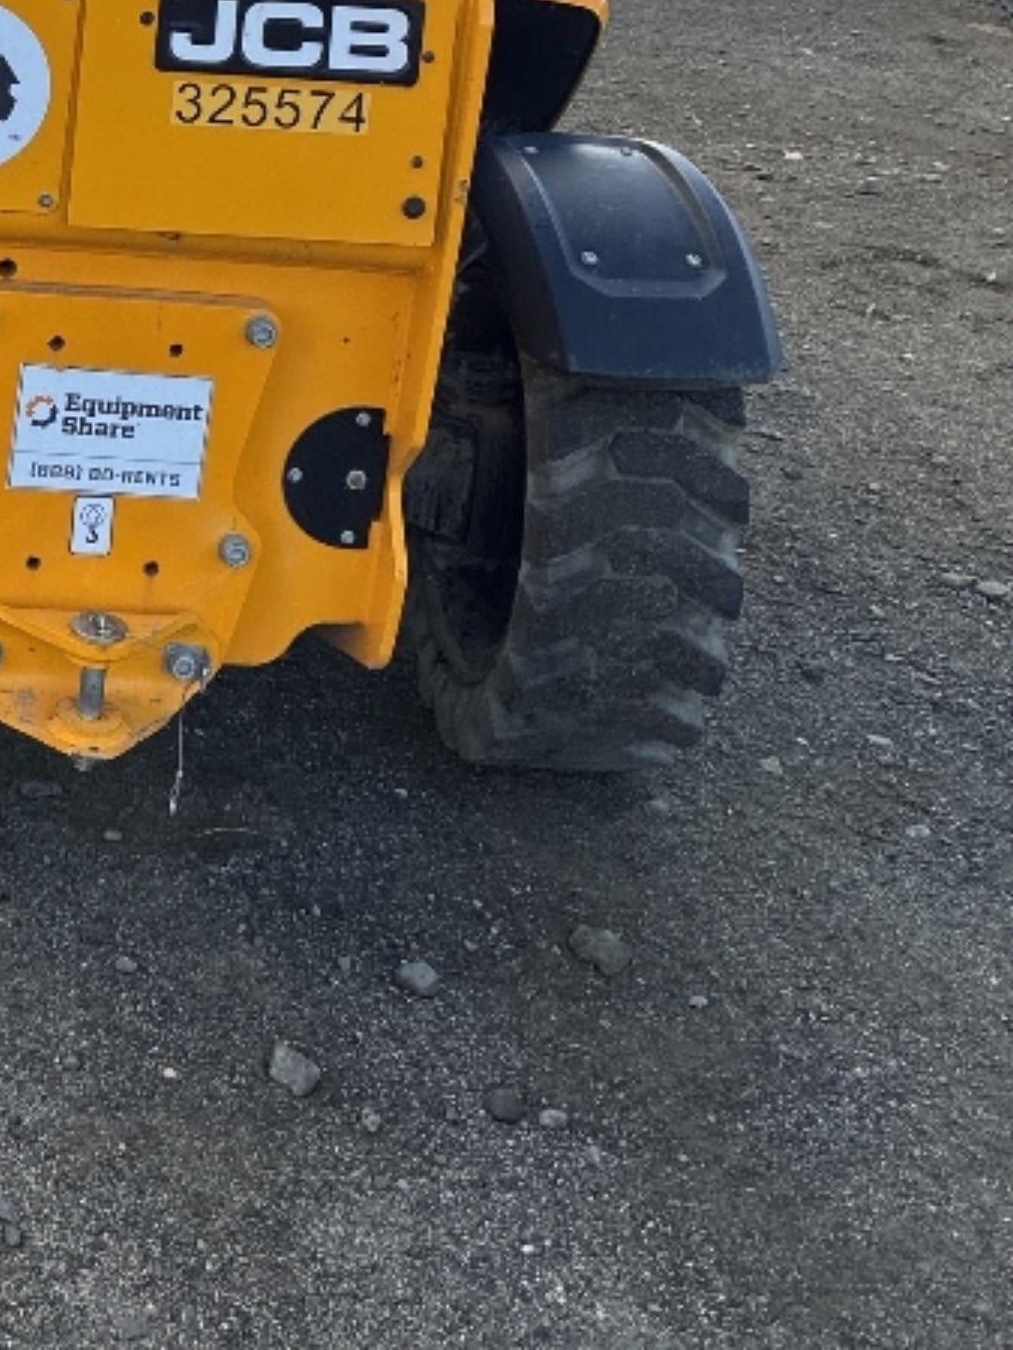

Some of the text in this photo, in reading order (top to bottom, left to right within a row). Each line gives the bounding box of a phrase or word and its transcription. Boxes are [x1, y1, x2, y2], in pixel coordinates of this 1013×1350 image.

[169, 0, 409, 73] JCB
[176, 83, 366, 132] 325574
[63, 392, 204, 421] Equipment
[61, 416, 136, 439] Share
